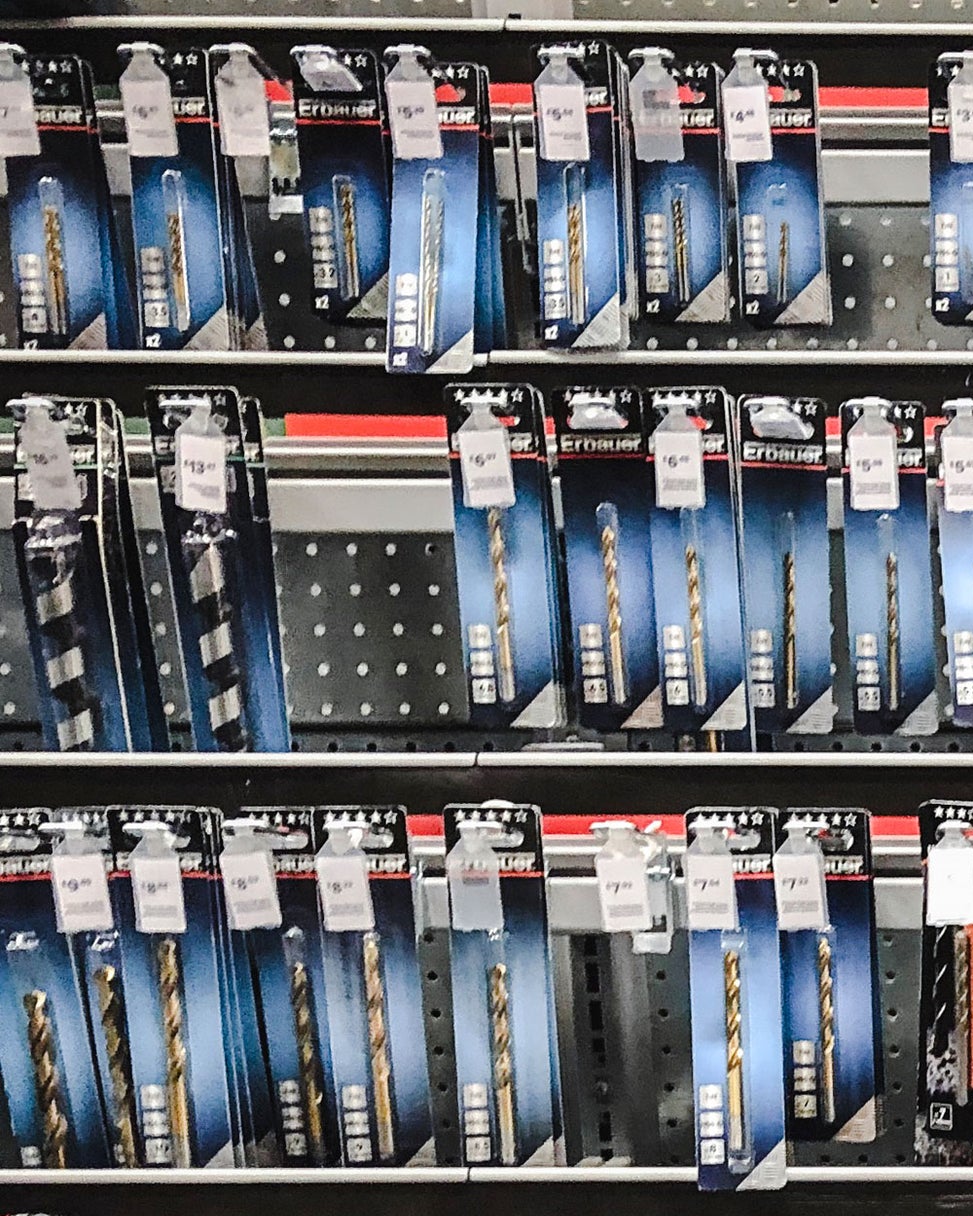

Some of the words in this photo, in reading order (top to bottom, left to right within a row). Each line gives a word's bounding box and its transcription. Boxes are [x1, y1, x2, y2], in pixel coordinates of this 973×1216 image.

[300, 100, 376, 118] Erbauer
[561, 435, 641, 451] Erbauer
[744, 442, 822, 462] Erbauer
